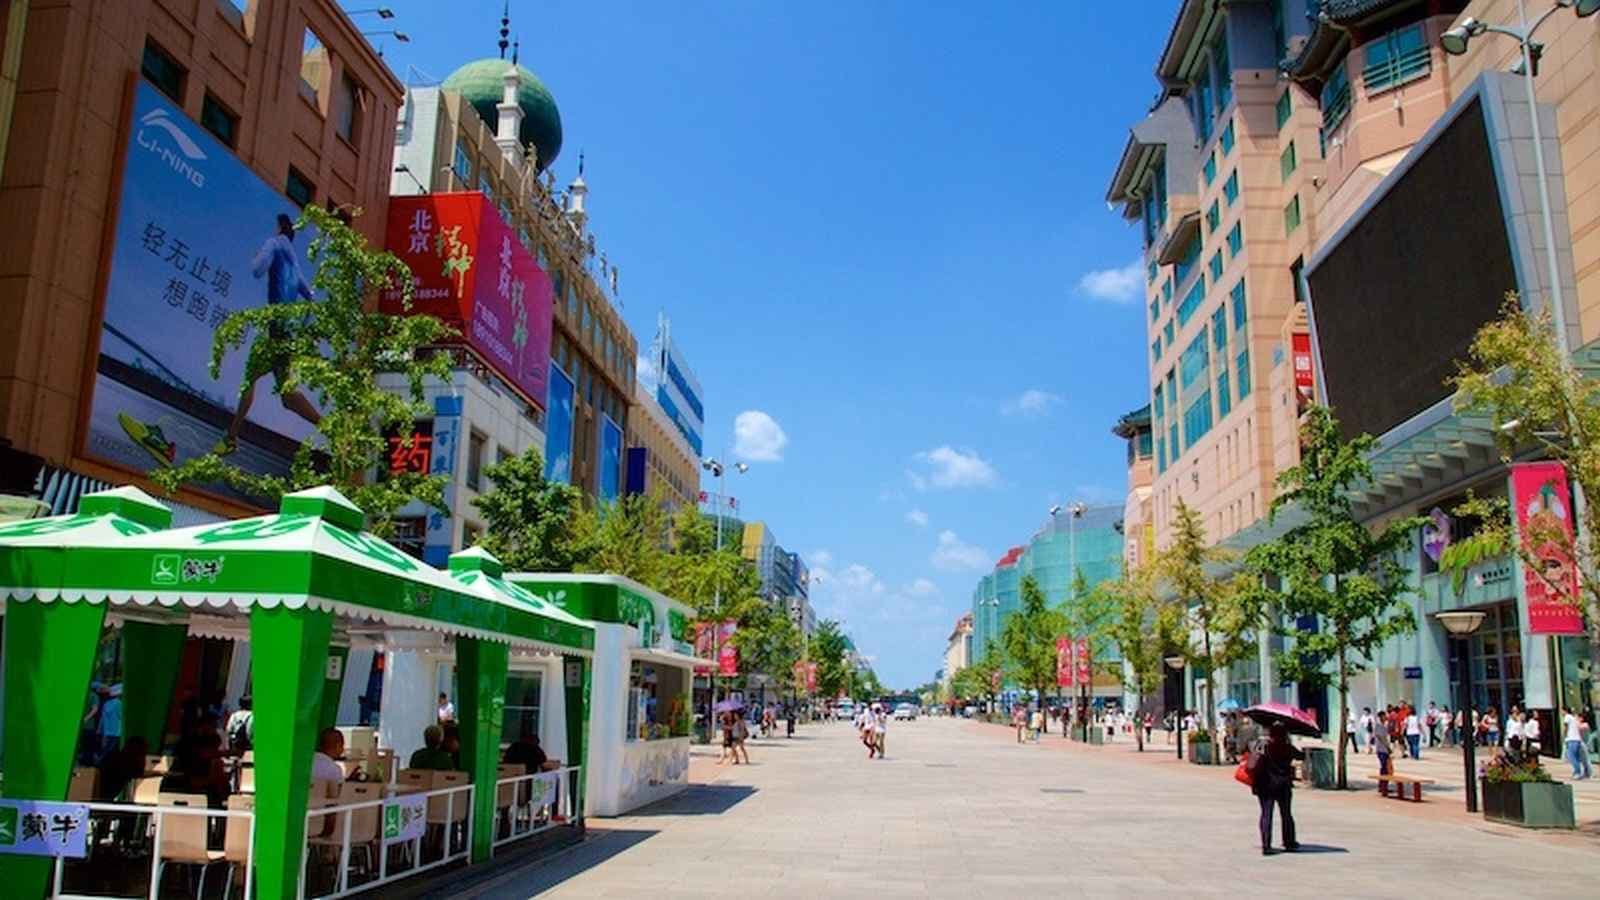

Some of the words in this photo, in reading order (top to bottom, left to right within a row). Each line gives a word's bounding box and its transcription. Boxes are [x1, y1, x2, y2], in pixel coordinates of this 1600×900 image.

[137, 130, 205, 188] LI-NING
[408, 209, 432, 254] 北京
[142, 222, 232, 298] 轻无止境
[388, 432, 433, 476] 药
[21, 812, 80, 844] 蒙牛
